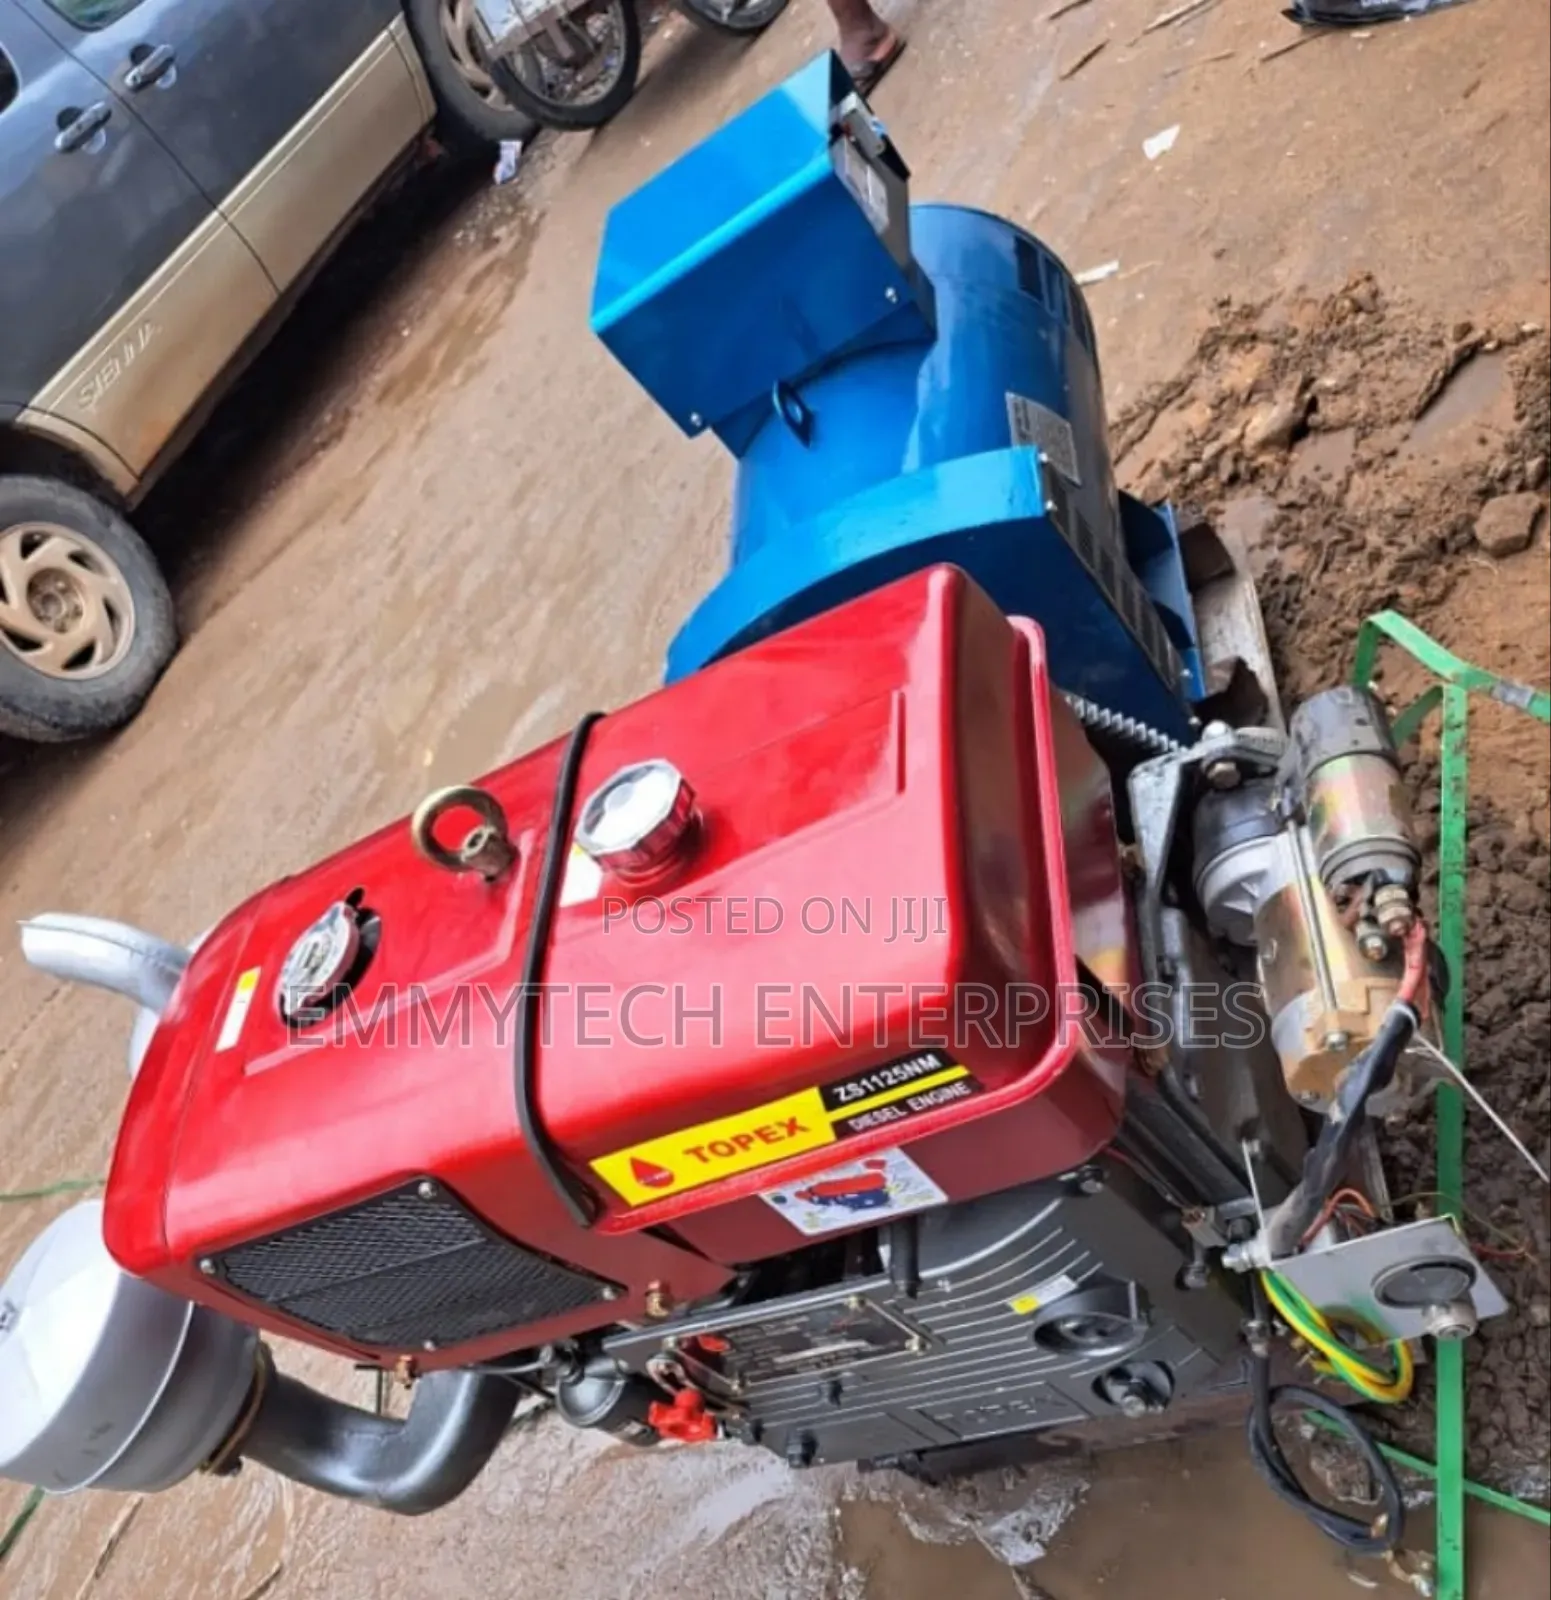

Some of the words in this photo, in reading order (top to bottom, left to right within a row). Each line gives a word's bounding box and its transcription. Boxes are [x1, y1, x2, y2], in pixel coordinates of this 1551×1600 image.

[832, 1054, 942, 1101] ZS1125NM
[848, 1105, 908, 1132] DIESEL
[906, 1081, 972, 1112] ENGINE
[682, 1116, 810, 1163] TOPEX
